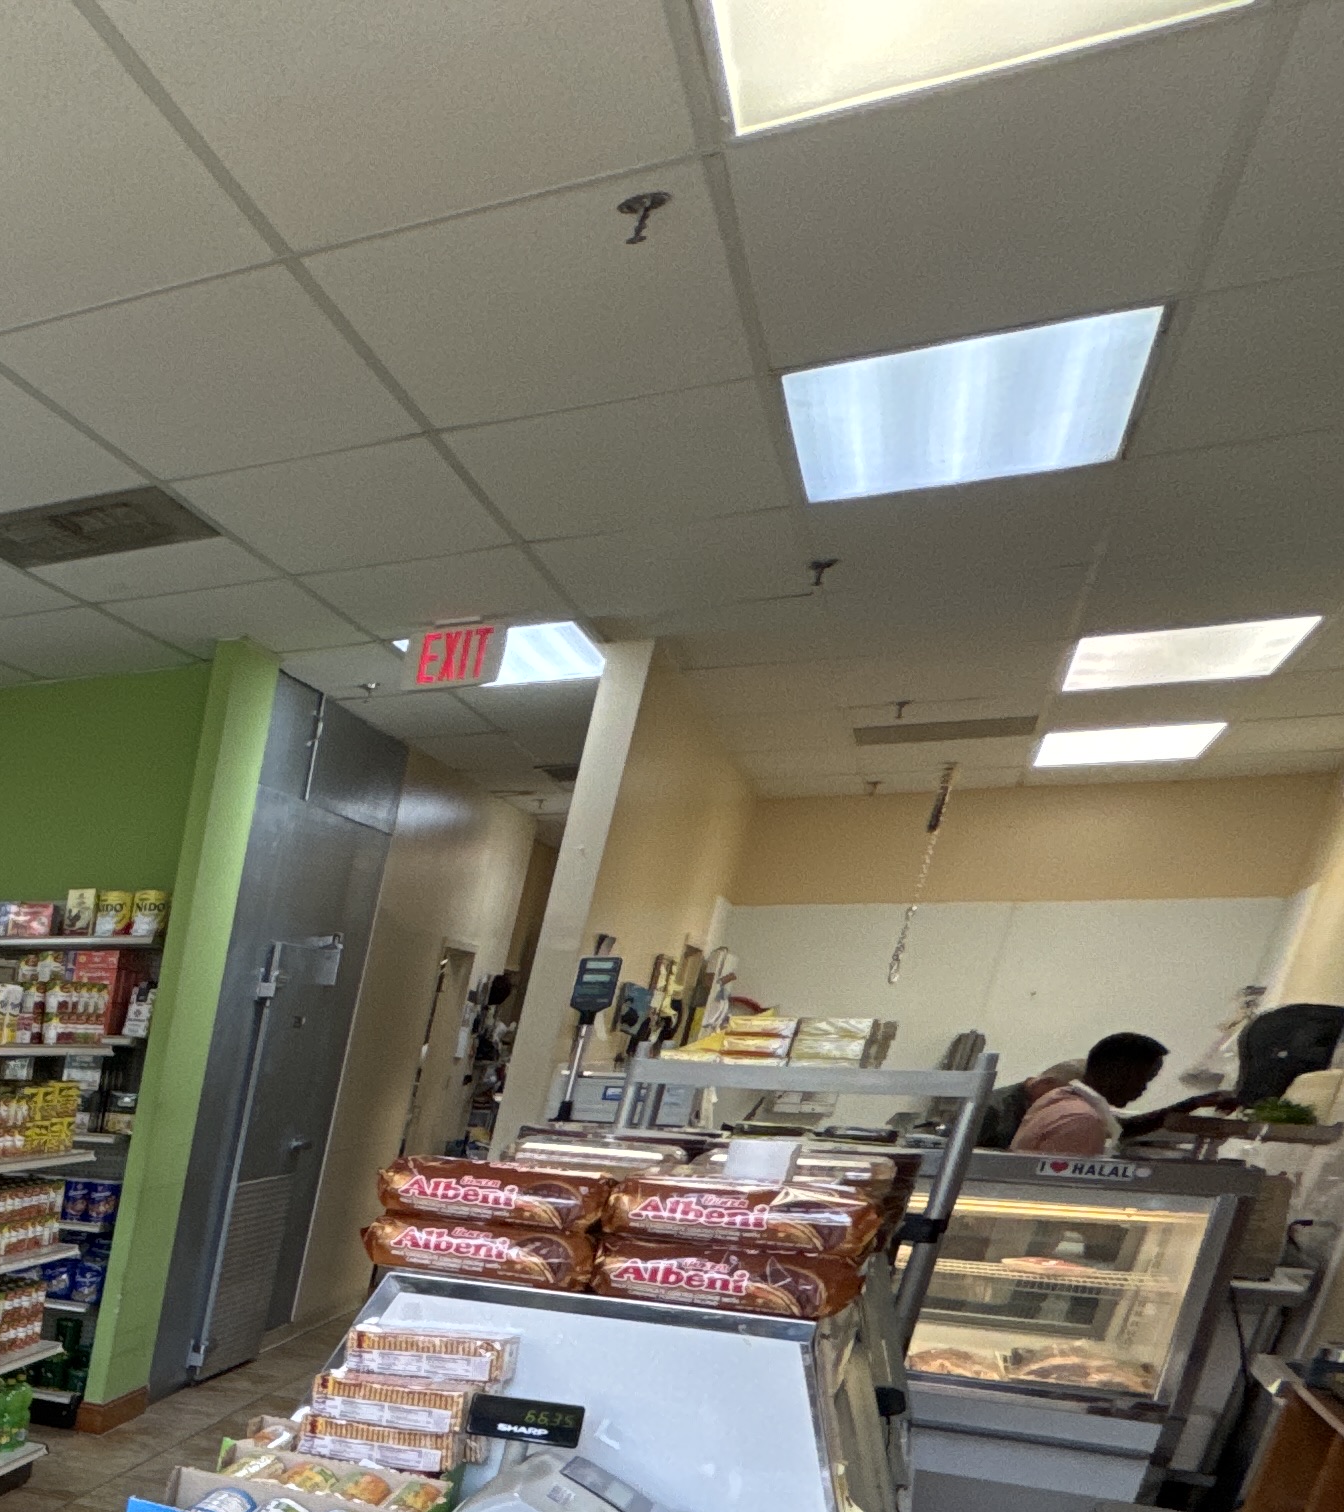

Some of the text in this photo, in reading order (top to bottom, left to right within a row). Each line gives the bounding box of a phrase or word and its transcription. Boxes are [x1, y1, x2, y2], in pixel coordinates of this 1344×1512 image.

[416, 626, 494, 686] EXIT
[135, 901, 166, 914] NIDO
[1039, 1160, 1131, 1179] I HALAL
[398, 1174, 518, 1210] Albeni
[628, 1196, 770, 1231] Albeni
[390, 1225, 512, 1263] Albeni
[611, 1257, 750, 1297] Albeni
[496, 1421, 550, 1437] SHARP
